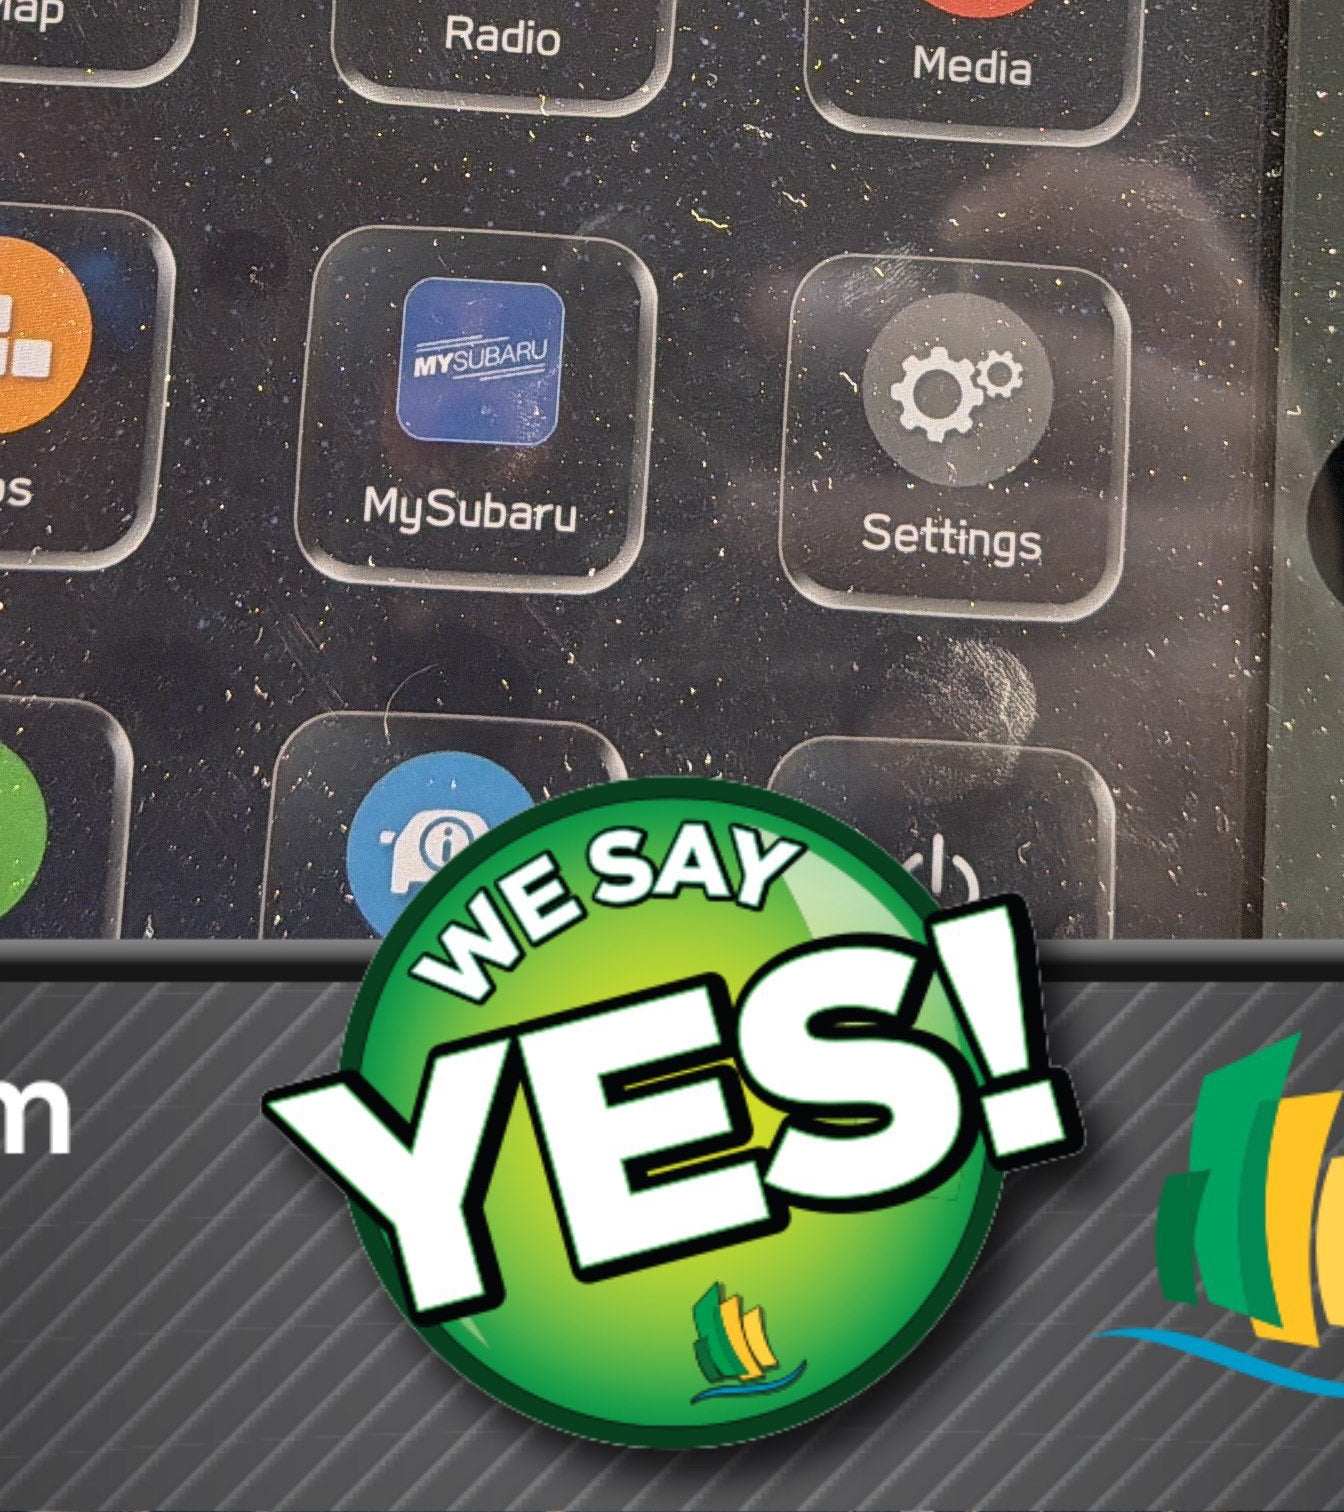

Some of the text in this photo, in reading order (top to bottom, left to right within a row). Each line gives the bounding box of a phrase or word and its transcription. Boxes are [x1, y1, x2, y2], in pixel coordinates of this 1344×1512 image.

[445, 15, 561, 57] Radio
[913, 44, 1033, 87] Media
[413, 338, 548, 378] MYSUBARU
[363, 486, 577, 535] MySubaru
[861, 513, 1043, 568] Settings
